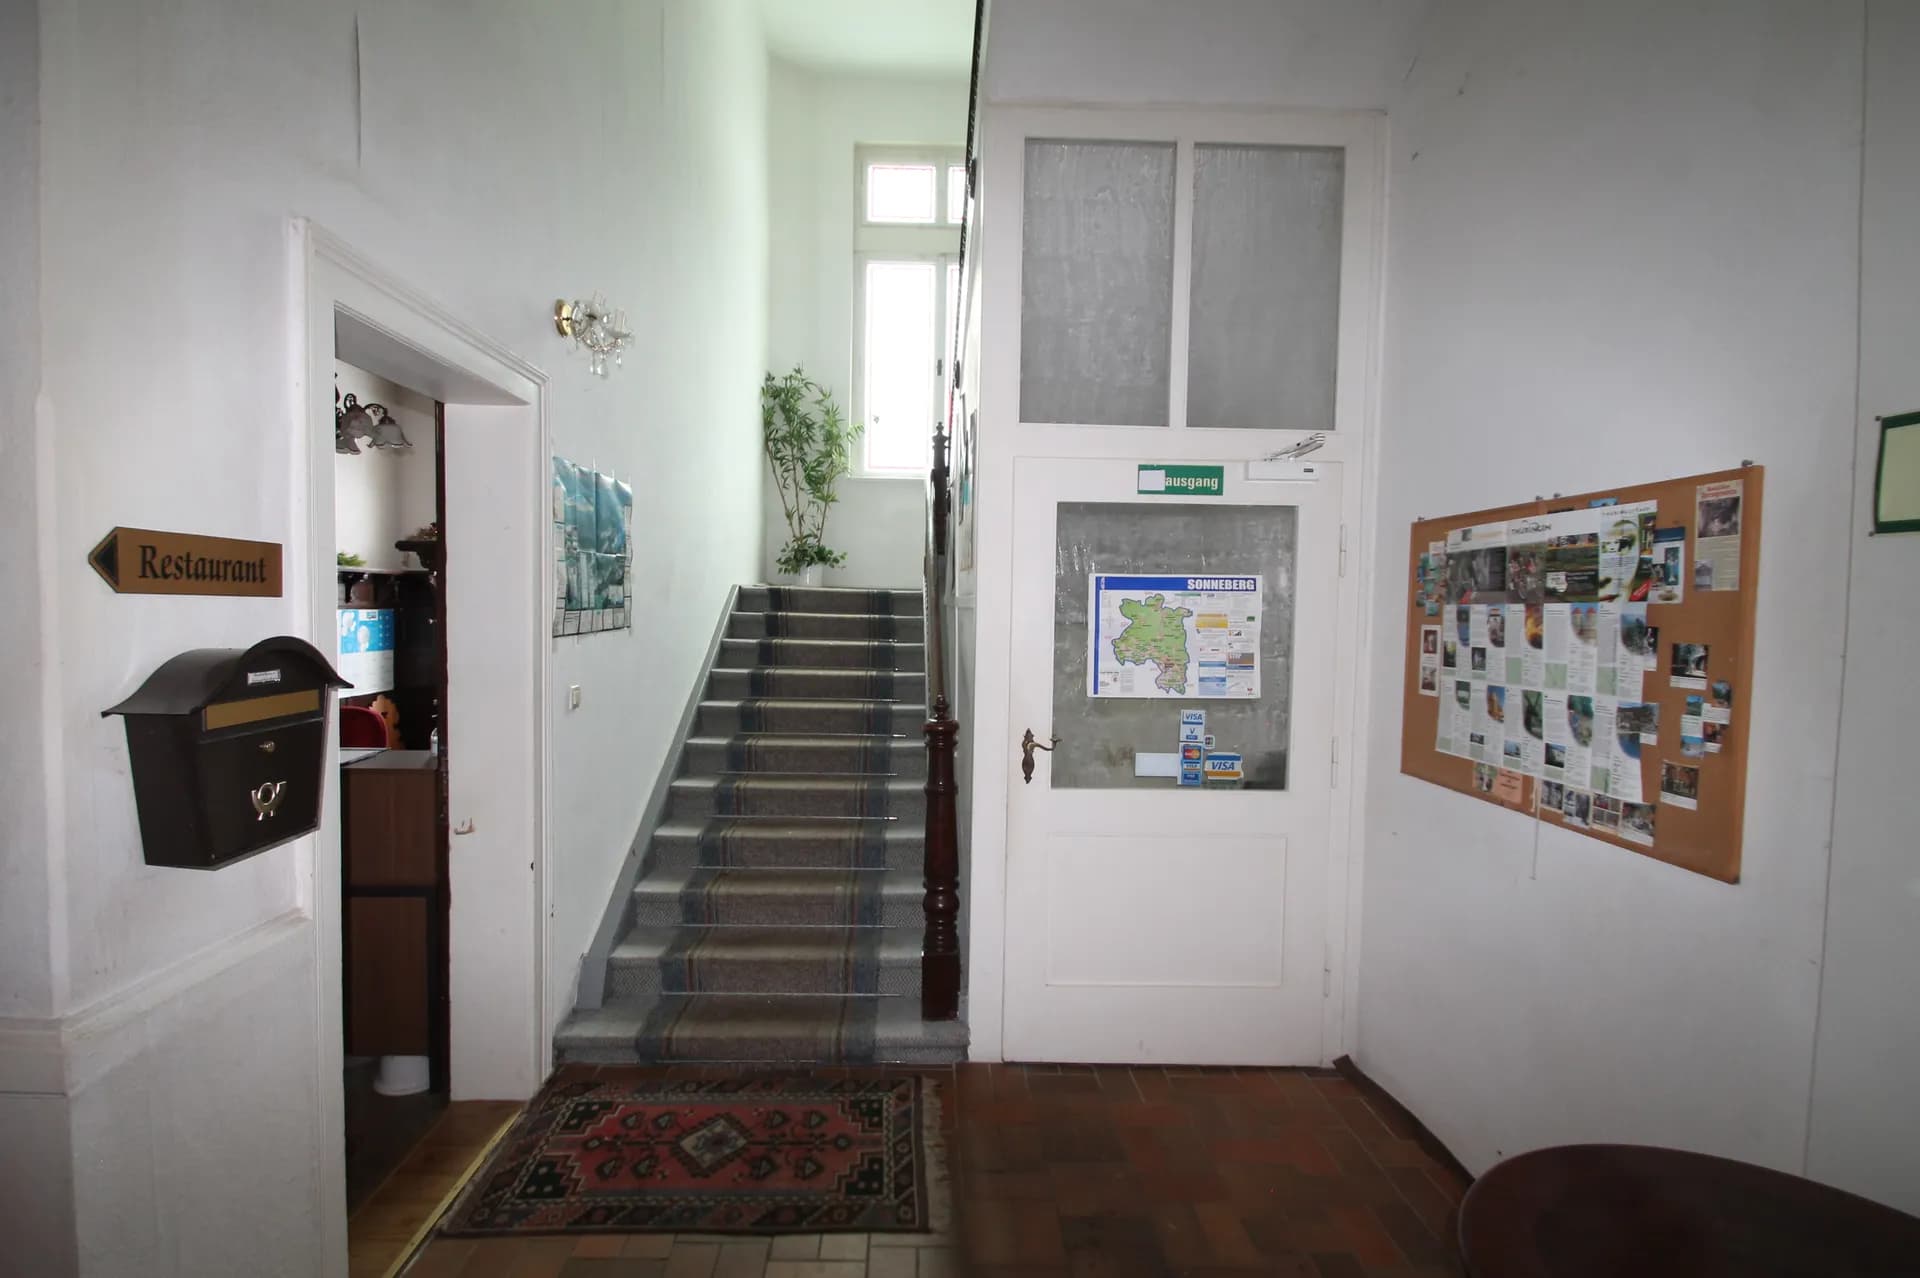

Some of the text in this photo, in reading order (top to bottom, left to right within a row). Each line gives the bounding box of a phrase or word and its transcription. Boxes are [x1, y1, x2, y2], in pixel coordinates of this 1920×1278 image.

[138, 544, 267, 584] Restaurant
[1187, 578, 1255, 590] SONNEBERG
[1185, 712, 1203, 721] VISA
[1211, 761, 1235, 770] VISA
